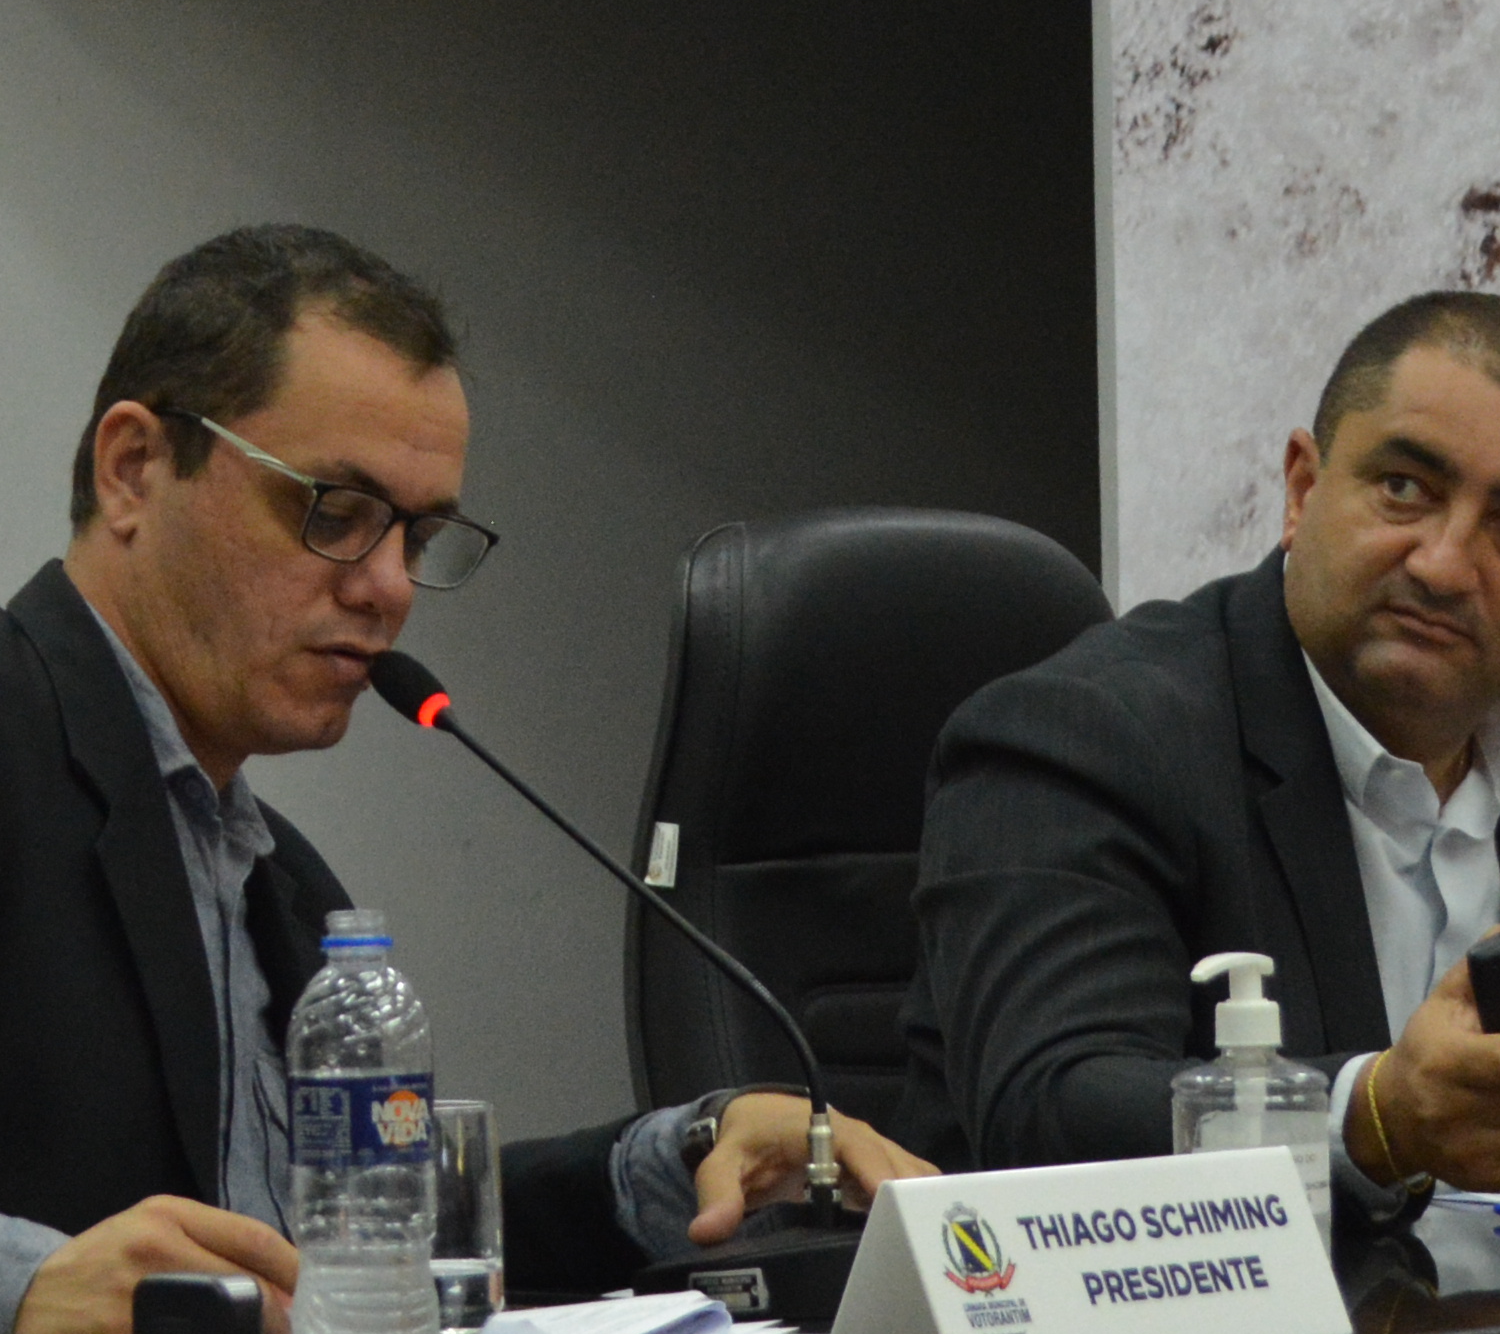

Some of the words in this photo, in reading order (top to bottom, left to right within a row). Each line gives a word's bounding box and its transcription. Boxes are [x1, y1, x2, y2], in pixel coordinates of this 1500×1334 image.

[371, 1098, 430, 1123] NOVA
[376, 1120, 428, 1145] VIDA
[1016, 1208, 1137, 1250] THIAGO
[1140, 1194, 1288, 1239] SCHIMING
[1082, 1255, 1269, 1305] PRESIDENTE
[966, 1308, 1032, 1328] VOTORANTIM
